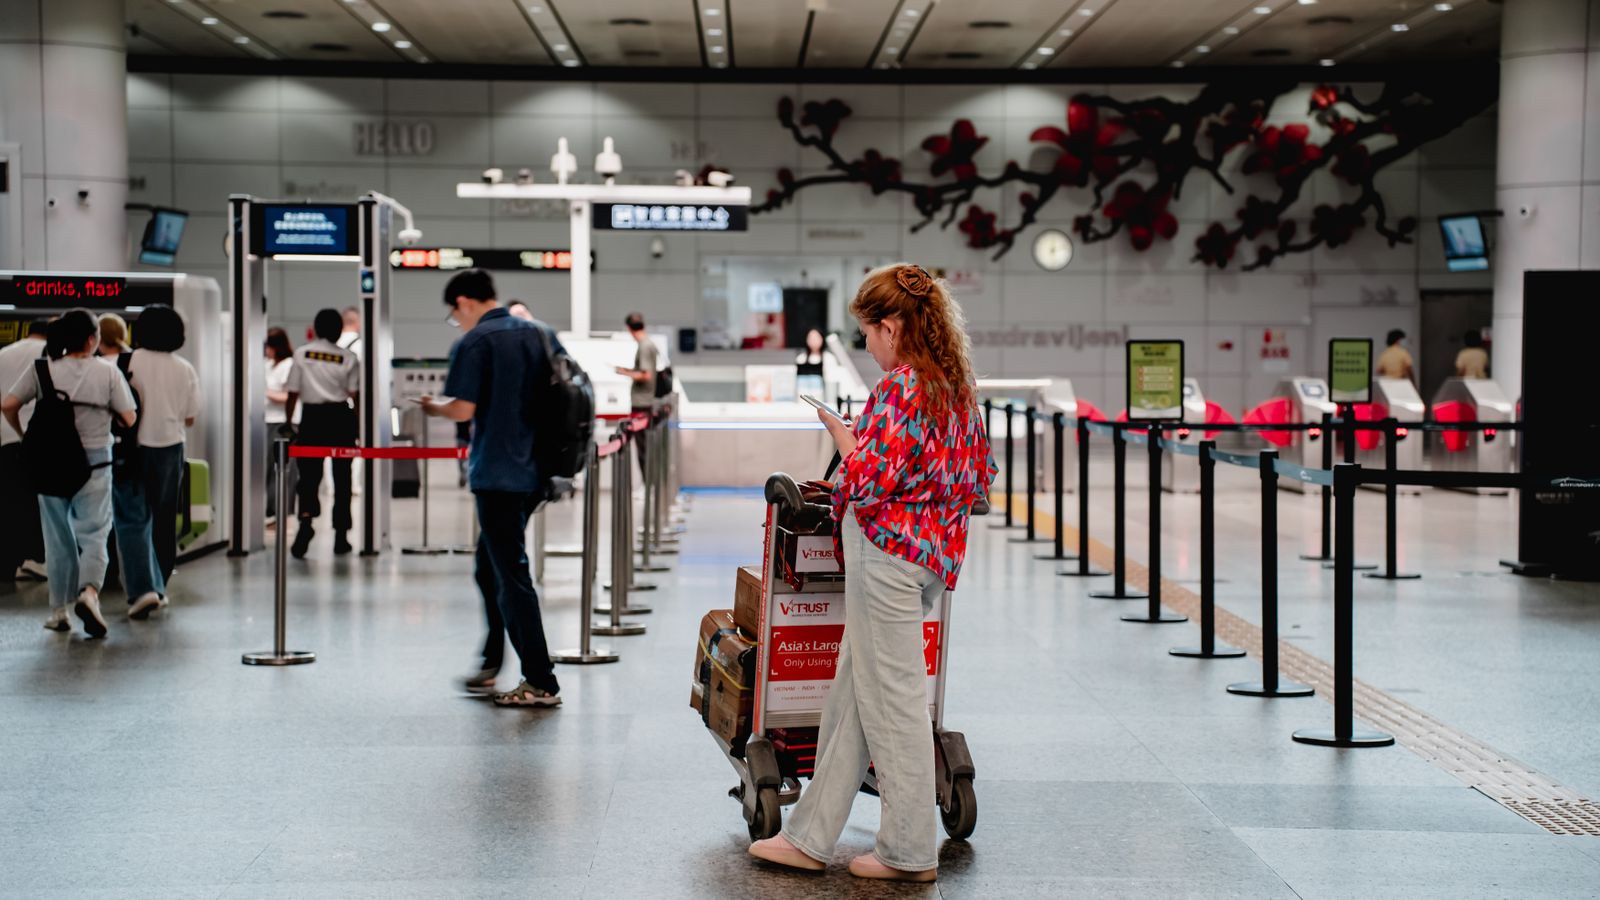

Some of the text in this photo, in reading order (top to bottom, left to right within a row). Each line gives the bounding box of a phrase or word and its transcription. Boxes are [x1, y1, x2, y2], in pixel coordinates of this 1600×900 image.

[352, 121, 436, 155] HELLO
[778, 641, 810, 652] Asia's
[784, 658, 805, 669] Only
[807, 658, 832, 667] Using
